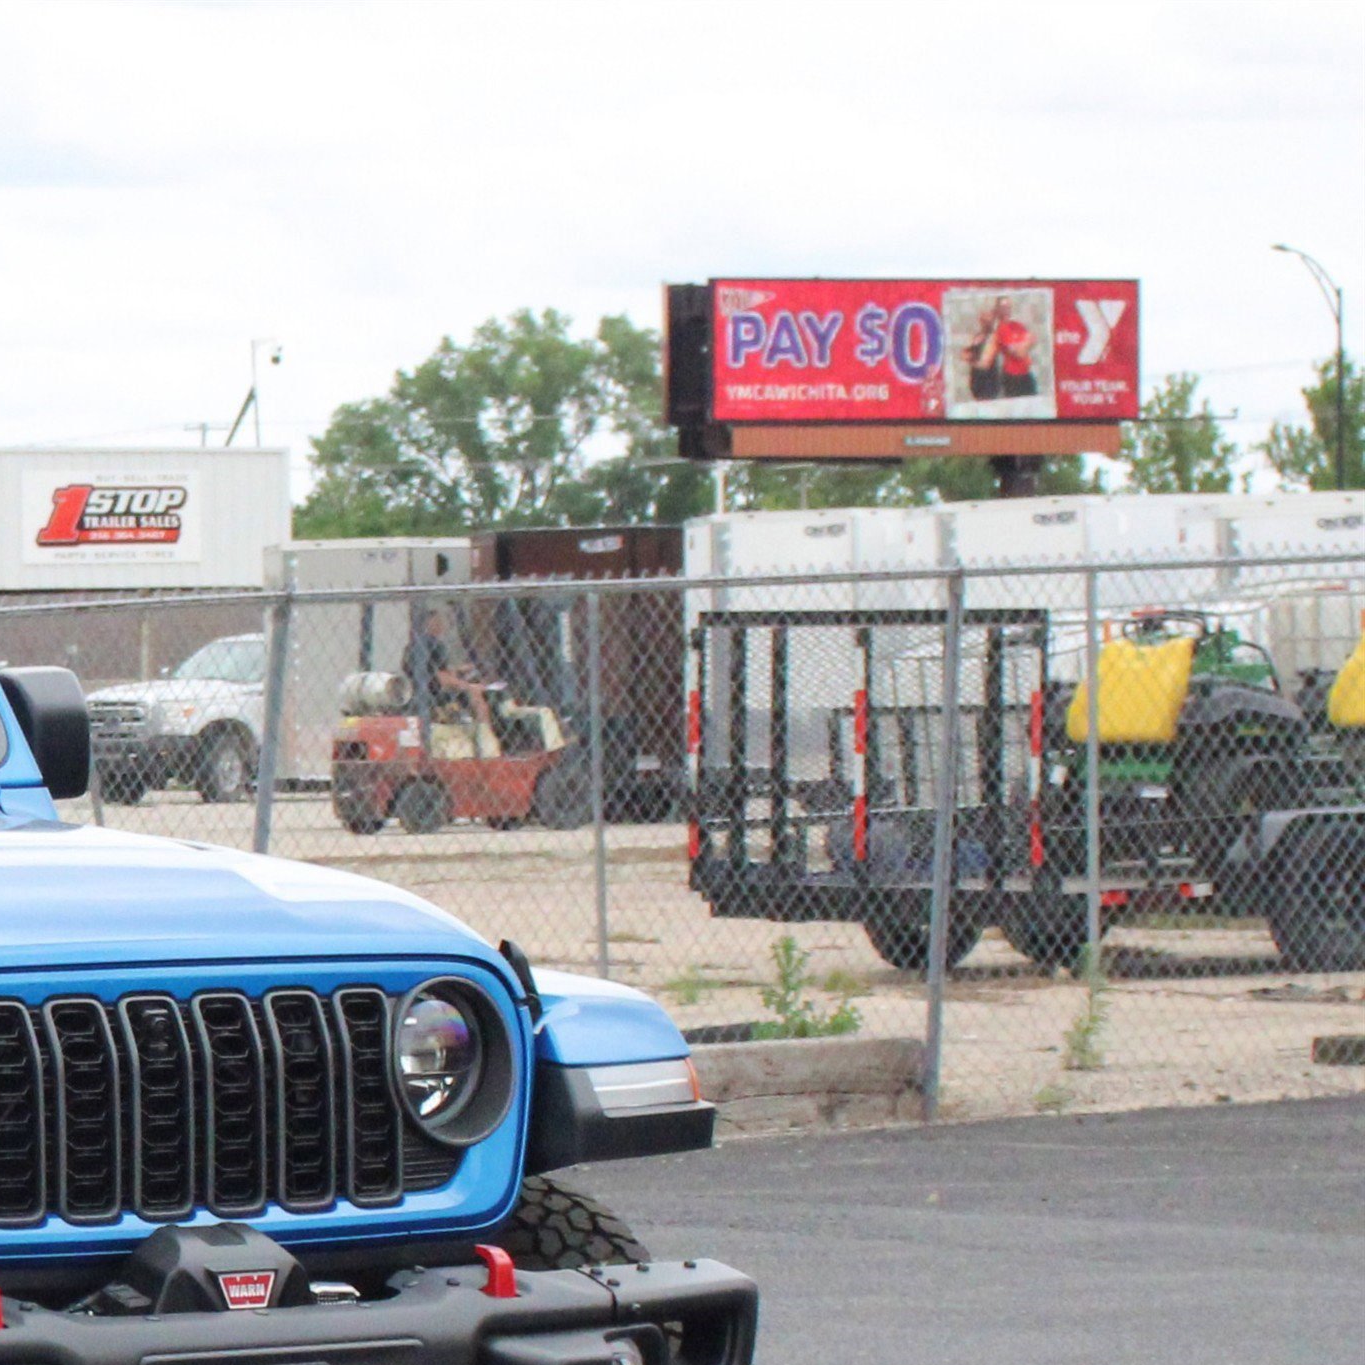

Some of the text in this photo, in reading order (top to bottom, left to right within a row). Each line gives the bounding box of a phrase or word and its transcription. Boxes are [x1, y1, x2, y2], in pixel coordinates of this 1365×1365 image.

[726, 301, 943, 384] PAY $0
[726, 383, 890, 402] YMCAWICHITA.ORG
[85, 488, 187, 515] STOP
[83, 514, 180, 529] TRAILER SALES
[228, 1283, 266, 1298] WARN
